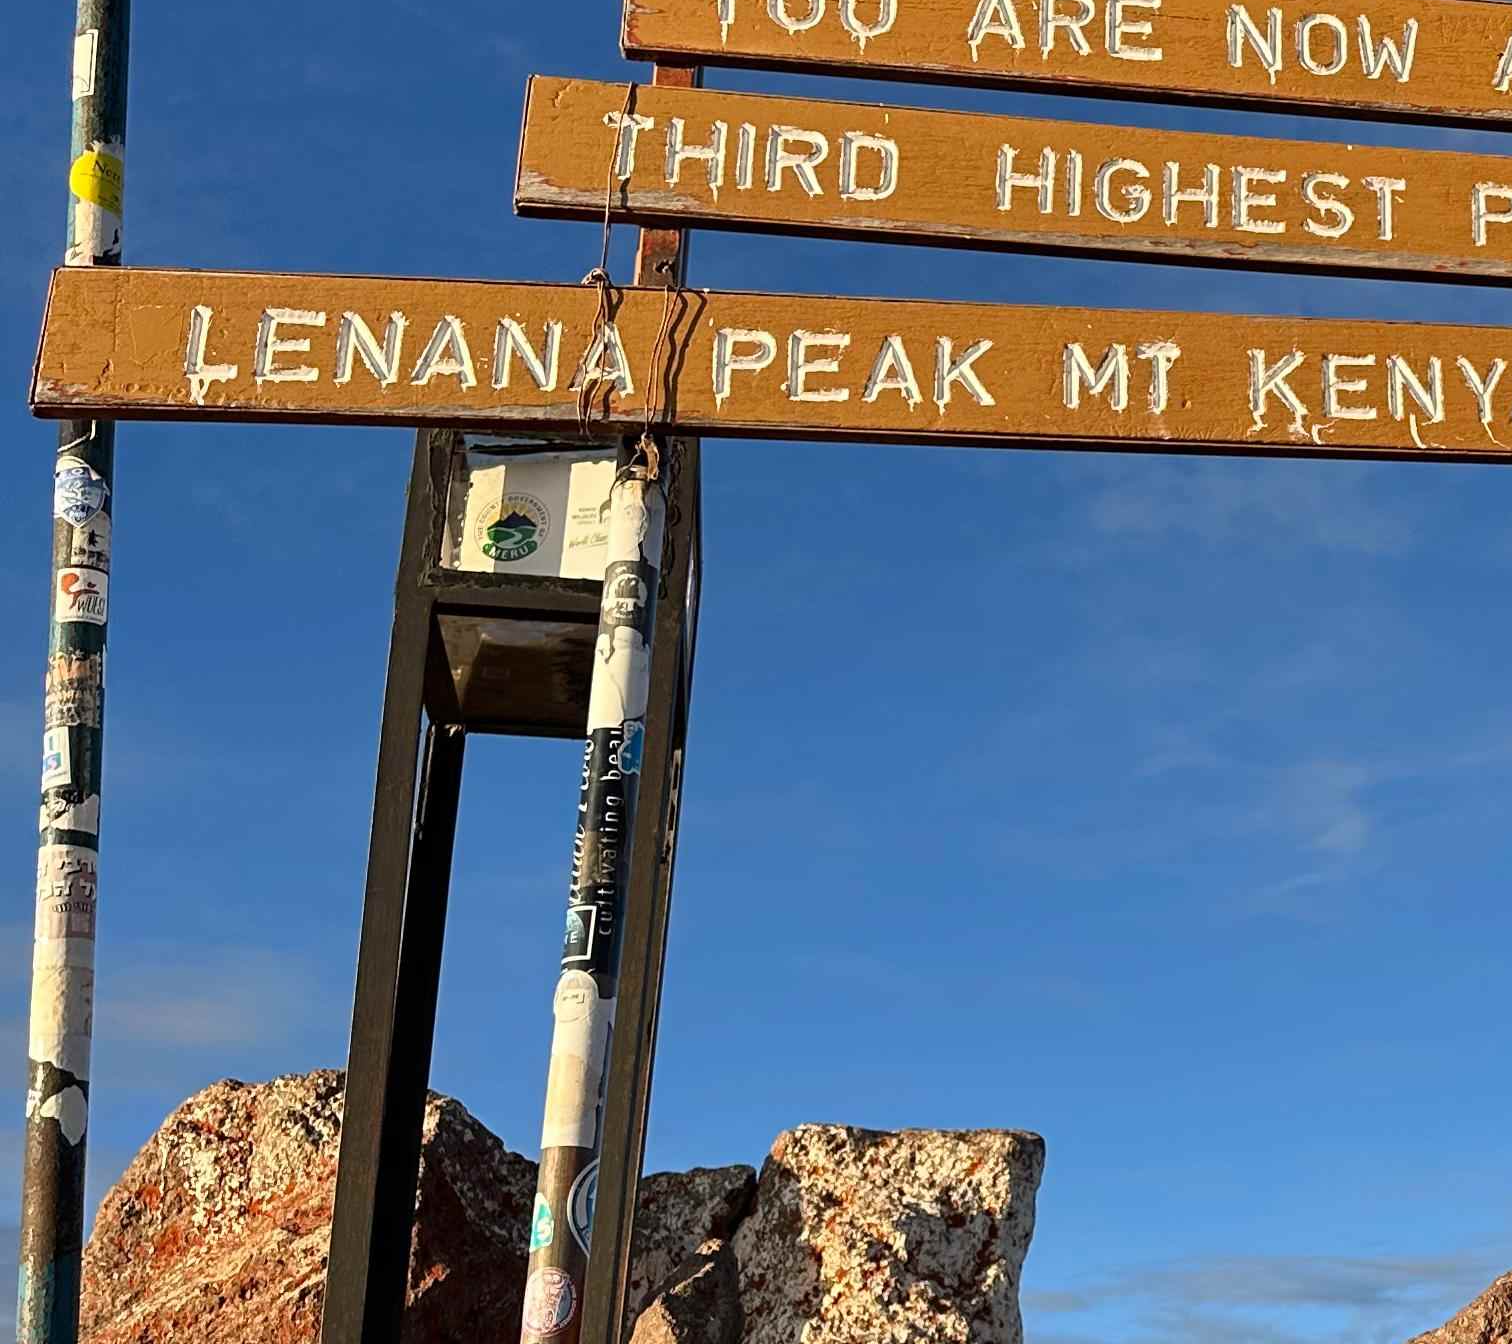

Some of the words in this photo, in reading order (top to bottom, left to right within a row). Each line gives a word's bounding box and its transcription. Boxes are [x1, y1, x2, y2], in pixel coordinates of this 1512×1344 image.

[1227, 5, 1418, 84] NOW
[602, 113, 898, 202] THIRD
[996, 146, 1406, 240] HIGHEST
[184, 305, 633, 404] LENANA
[712, 328, 994, 414] PEAK
[1063, 340, 1180, 415] MT
[488, 545, 530, 560] MERU
[598, 794, 624, 936] cultivating
